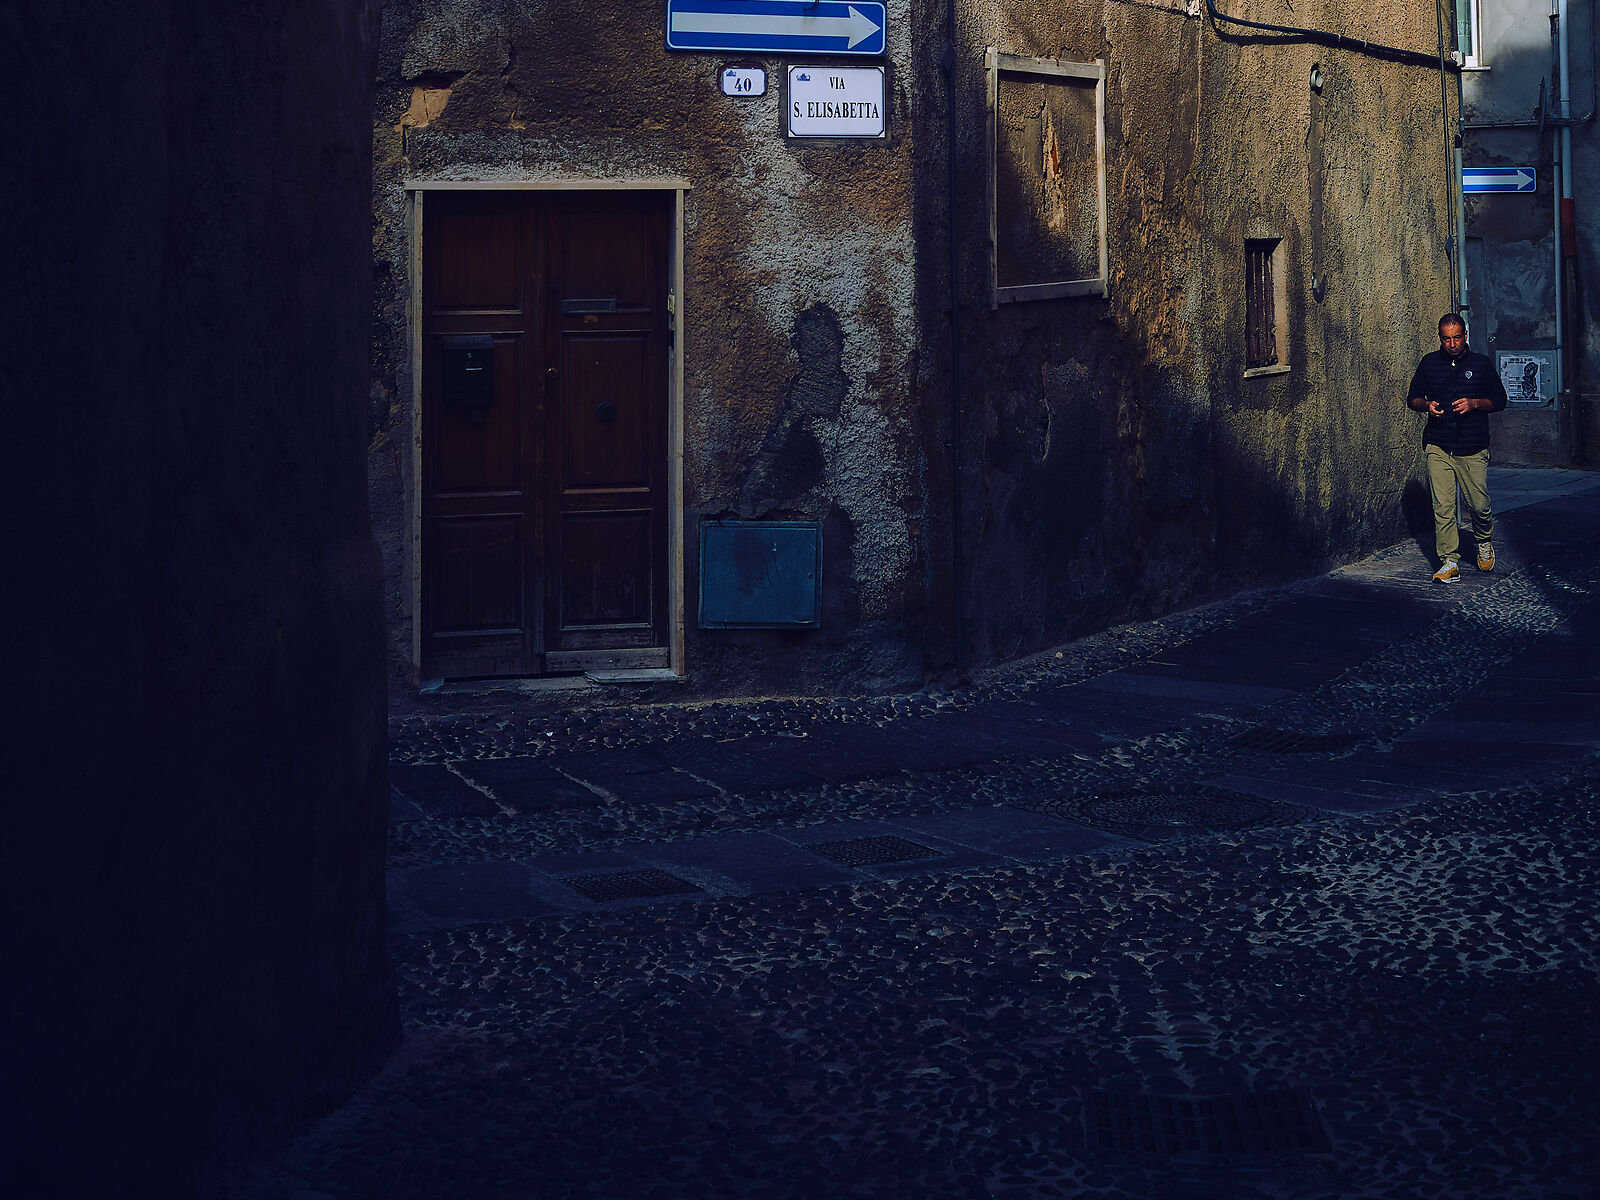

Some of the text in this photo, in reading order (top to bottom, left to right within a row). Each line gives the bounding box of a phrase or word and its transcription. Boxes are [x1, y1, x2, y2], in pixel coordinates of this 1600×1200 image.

[734, 77, 752, 92] 40
[829, 76, 846, 90] VIA
[793, 102, 880, 119] S. ELISABETTA
